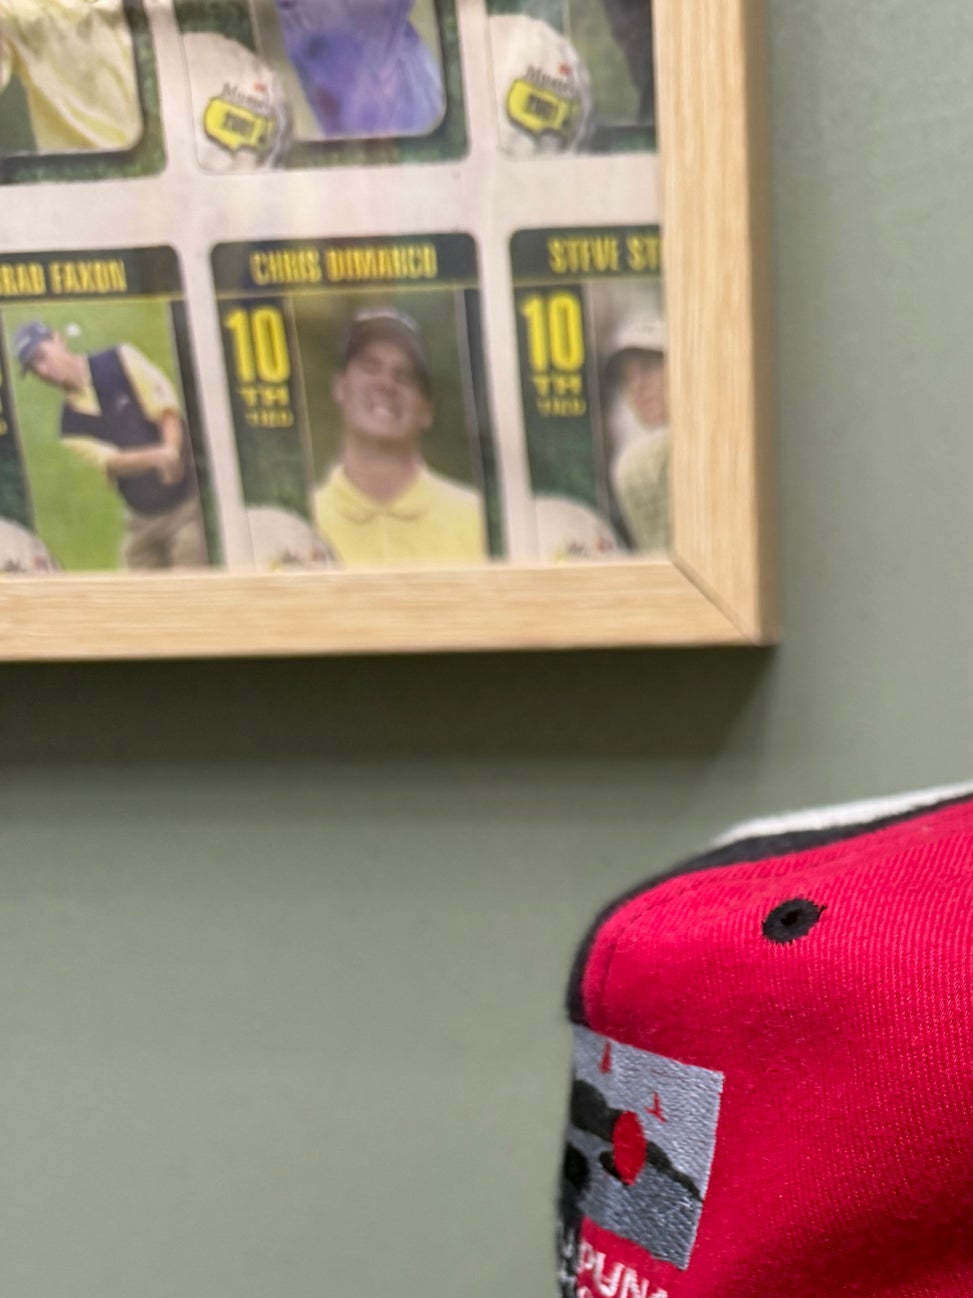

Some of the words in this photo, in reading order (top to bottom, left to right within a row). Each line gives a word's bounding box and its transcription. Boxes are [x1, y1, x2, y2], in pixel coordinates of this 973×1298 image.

[251, 247, 322, 285] CHRIS
[325, 242, 437, 281] DIMARCO
[546, 236, 619, 273] STEVE
[50, 259, 127, 294] FAXON
[223, 306, 290, 383] 10
[522, 292, 585, 372] 10
[240, 387, 289, 407] TH
[533, 374, 583, 397] TH
